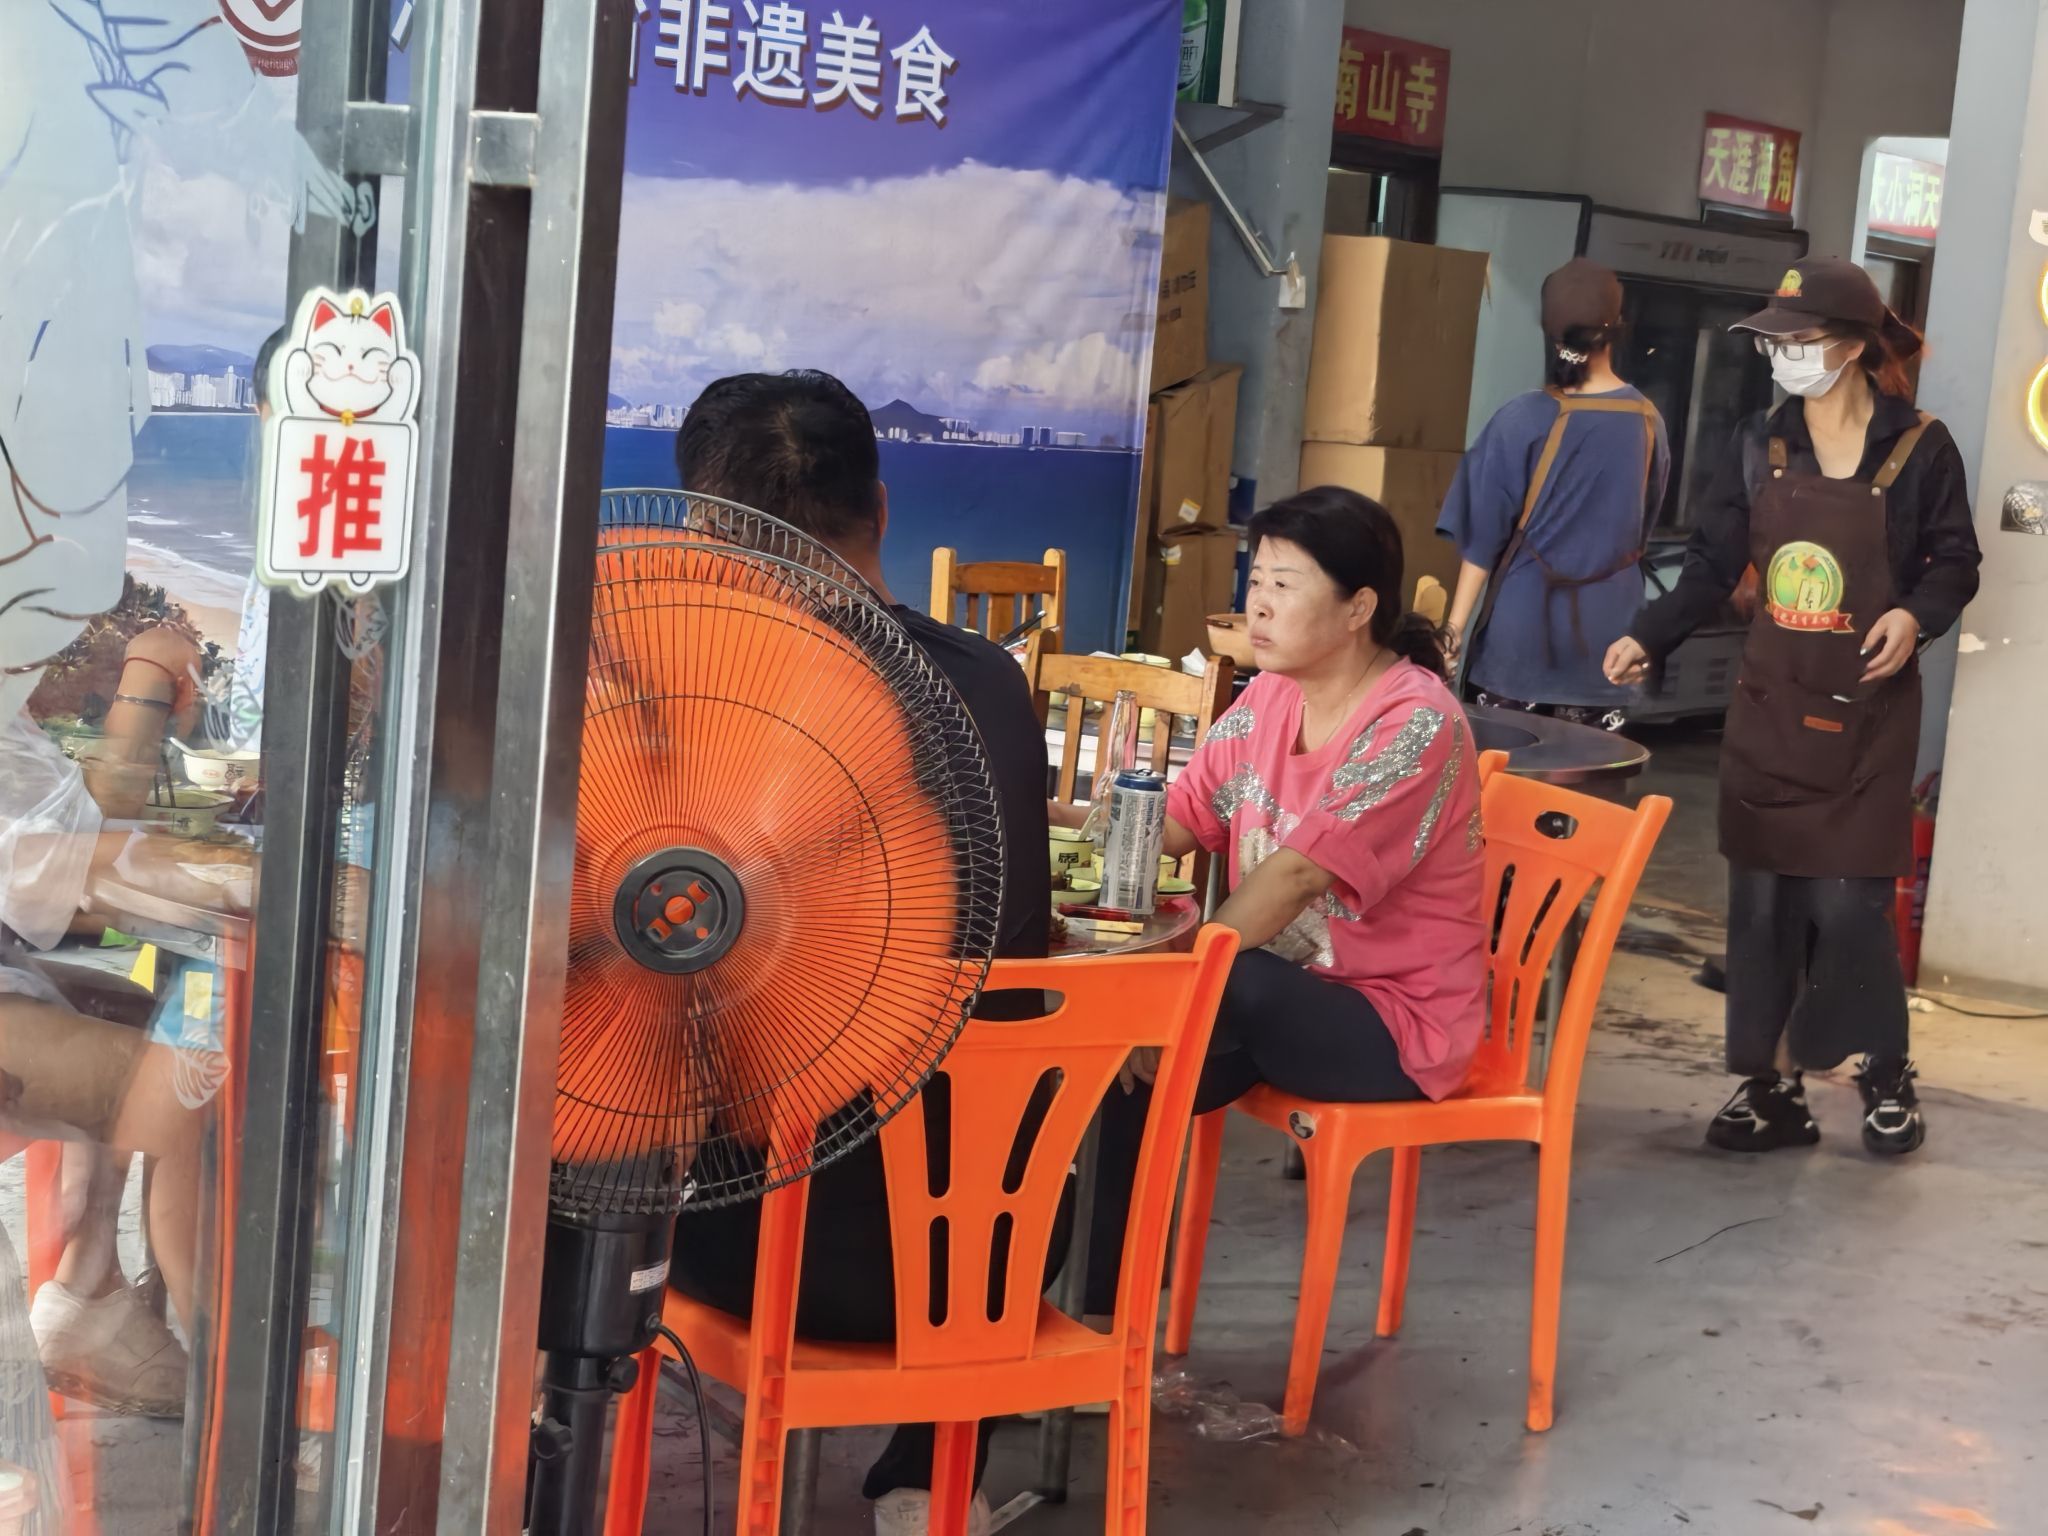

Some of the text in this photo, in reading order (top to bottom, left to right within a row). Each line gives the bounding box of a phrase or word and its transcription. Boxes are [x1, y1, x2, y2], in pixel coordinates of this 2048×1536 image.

[629, 0, 954, 121] 非遗美食
[1336, 40, 1437, 133] 南山寺
[297, 434, 386, 558] 推
